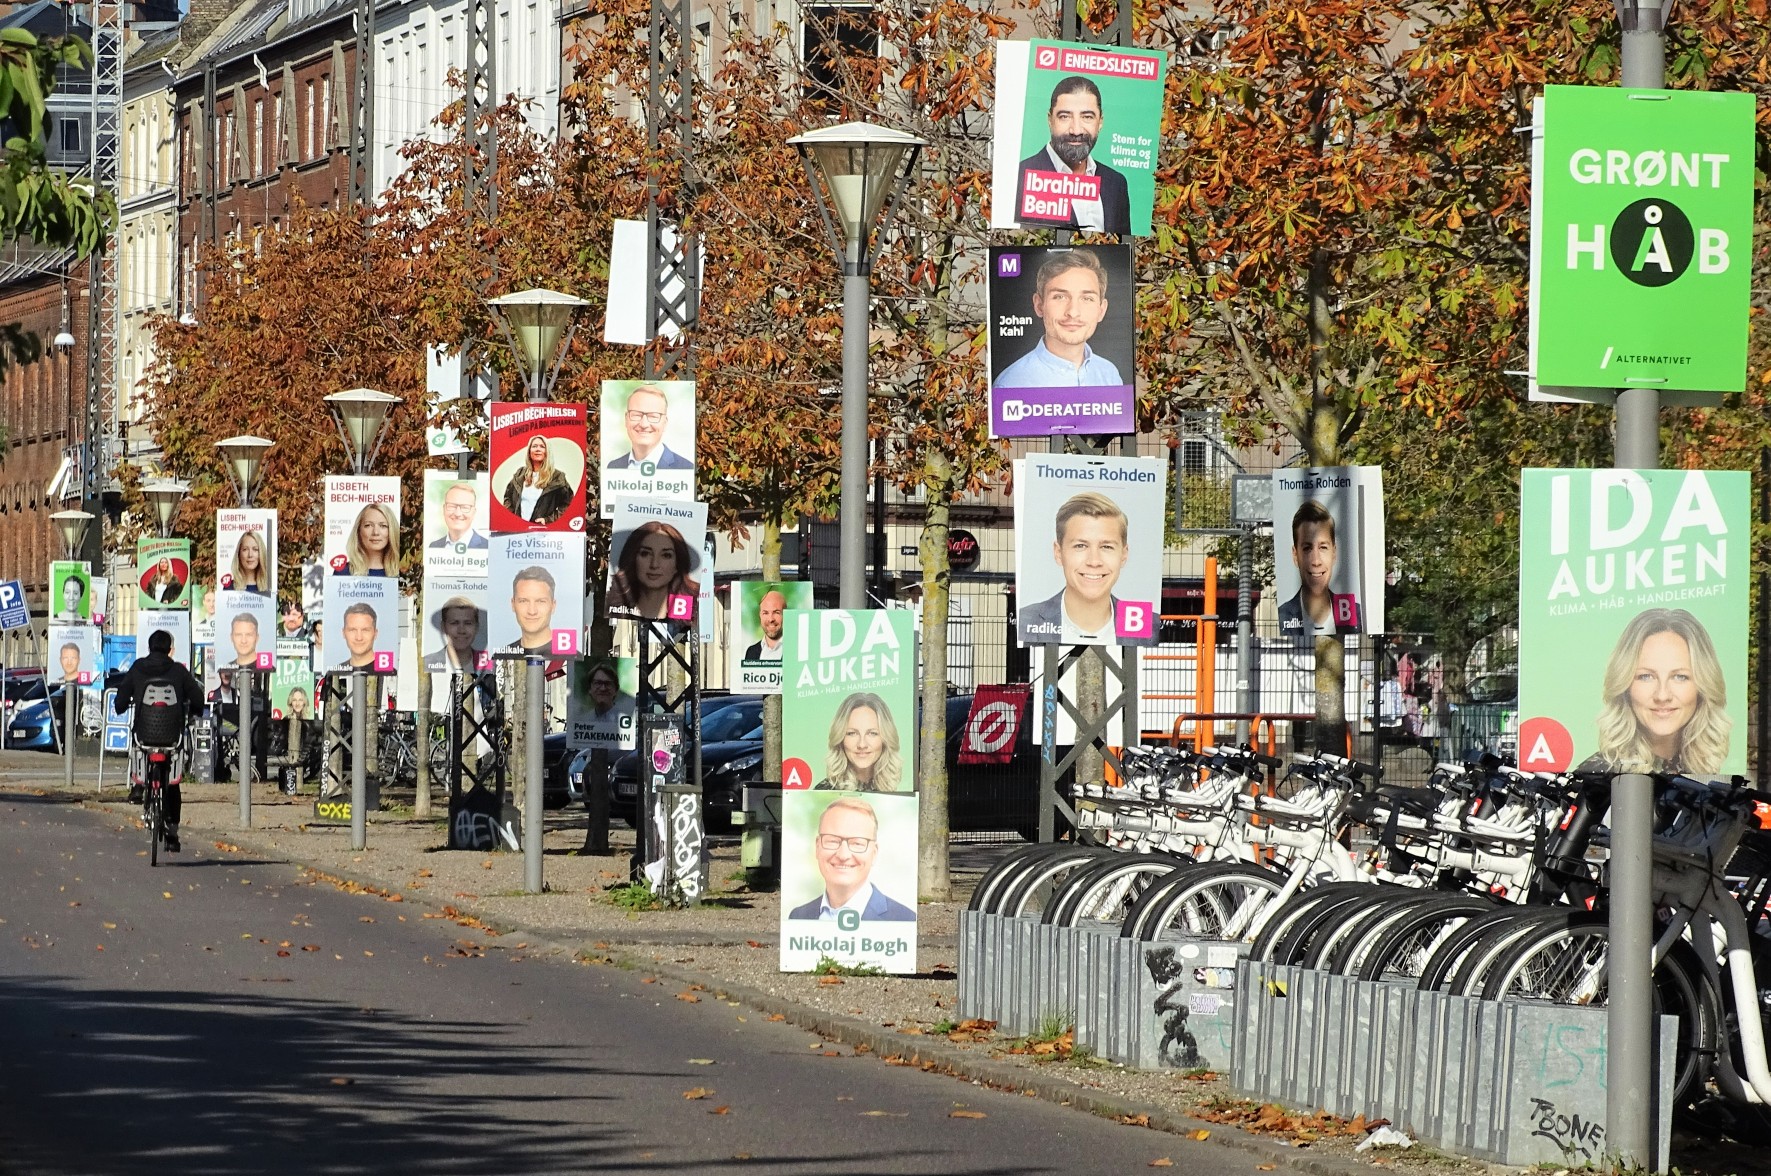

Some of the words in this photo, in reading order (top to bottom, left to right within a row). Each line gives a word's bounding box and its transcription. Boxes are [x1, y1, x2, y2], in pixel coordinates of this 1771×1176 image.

[1065, 53, 1155, 76] ENHEDSLISTEN
[1112, 133, 1136, 146] Stem
[1138, 135, 1152, 147] for
[1111, 145, 1136, 157] klima
[1139, 149, 1151, 160] og
[1113, 157, 1149, 169] velfærd
[1569, 148, 1730, 188] GRØNT
[1026, 173, 1097, 198] Ibrahim
[1024, 195, 1068, 216] Benli
[1566, 204, 1730, 274] HÅB
[1002, 258, 1017, 273] M
[1000, 315, 1032, 325] Johan
[1000, 326, 1024, 336] Kahl
[1616, 355, 1692, 365] ALTERNATIVET
[1003, 401, 1122, 420] MODERATERNE
[493, 410, 524, 432] LISBETH
[524, 407, 577, 421] BECH-NIELSEN
[509, 423, 530, 437] LIGHED
[434, 436, 445, 444] SF
[1036, 465, 1095, 480] Thomas
[1099, 467, 1156, 482] Rohden
[330, 482, 369, 491] LISBETH
[607, 480, 652, 493] Nikolaj
[656, 480, 688, 493] Bøgh
[1279, 478, 1314, 491] Thomas
[1316, 476, 1351, 488] Rohden
[330, 494, 395, 503] BECH-NIELSEN
[220, 514, 246, 522] LISBETH
[628, 504, 662, 516] Samira
[665, 507, 693, 518] Nawa
[1550, 469, 1728, 556] IDA
[220, 524, 263, 532] BECH-NIELSEN
[507, 539, 522, 549] Jes
[525, 538, 563, 550] Vissing
[506, 550, 565, 560] Tiedemann
[333, 558, 345, 567] SF
[429, 557, 464, 568] Nikolaj
[1547, 539, 1727, 600] AUKEN
[339, 581, 350, 590] Jes
[353, 581, 382, 590] Vissing
[431, 582, 461, 590] Thomas
[0, 586, 15, 610] P
[337, 590, 384, 598] Tiedemann
[1550, 602, 1588, 617] KLIMA
[1600, 593, 1625, 609] HÅB
[1637, 584, 1727, 606] HANDLEKRAFT
[673, 599, 687, 615] B
[1338, 598, 1351, 621] B
[1124, 606, 1144, 632] B
[557, 633, 571, 650] B
[797, 609, 901, 662] IDA
[493, 646, 524, 654] radikale
[260, 655, 269, 666] B
[378, 654, 390, 668] B
[276, 660, 309, 677] IDA
[796, 650, 900, 688] AUKEN
[80, 673, 88, 681] B
[277, 674, 309, 686] AUKEN
[743, 672, 766, 683] Rico
[798, 689, 819, 698] KLIMA
[825, 685, 840, 694] HÅB
[848, 678, 899, 691] HANDLEKRAFT
[574, 723, 595, 731] Peter
[573, 731, 631, 742] STAKEMANN
[1527, 732, 1556, 763] A
[786, 767, 802, 785] A
[789, 936, 856, 956] Nikolaj
[861, 938, 908, 957] Bøgh
